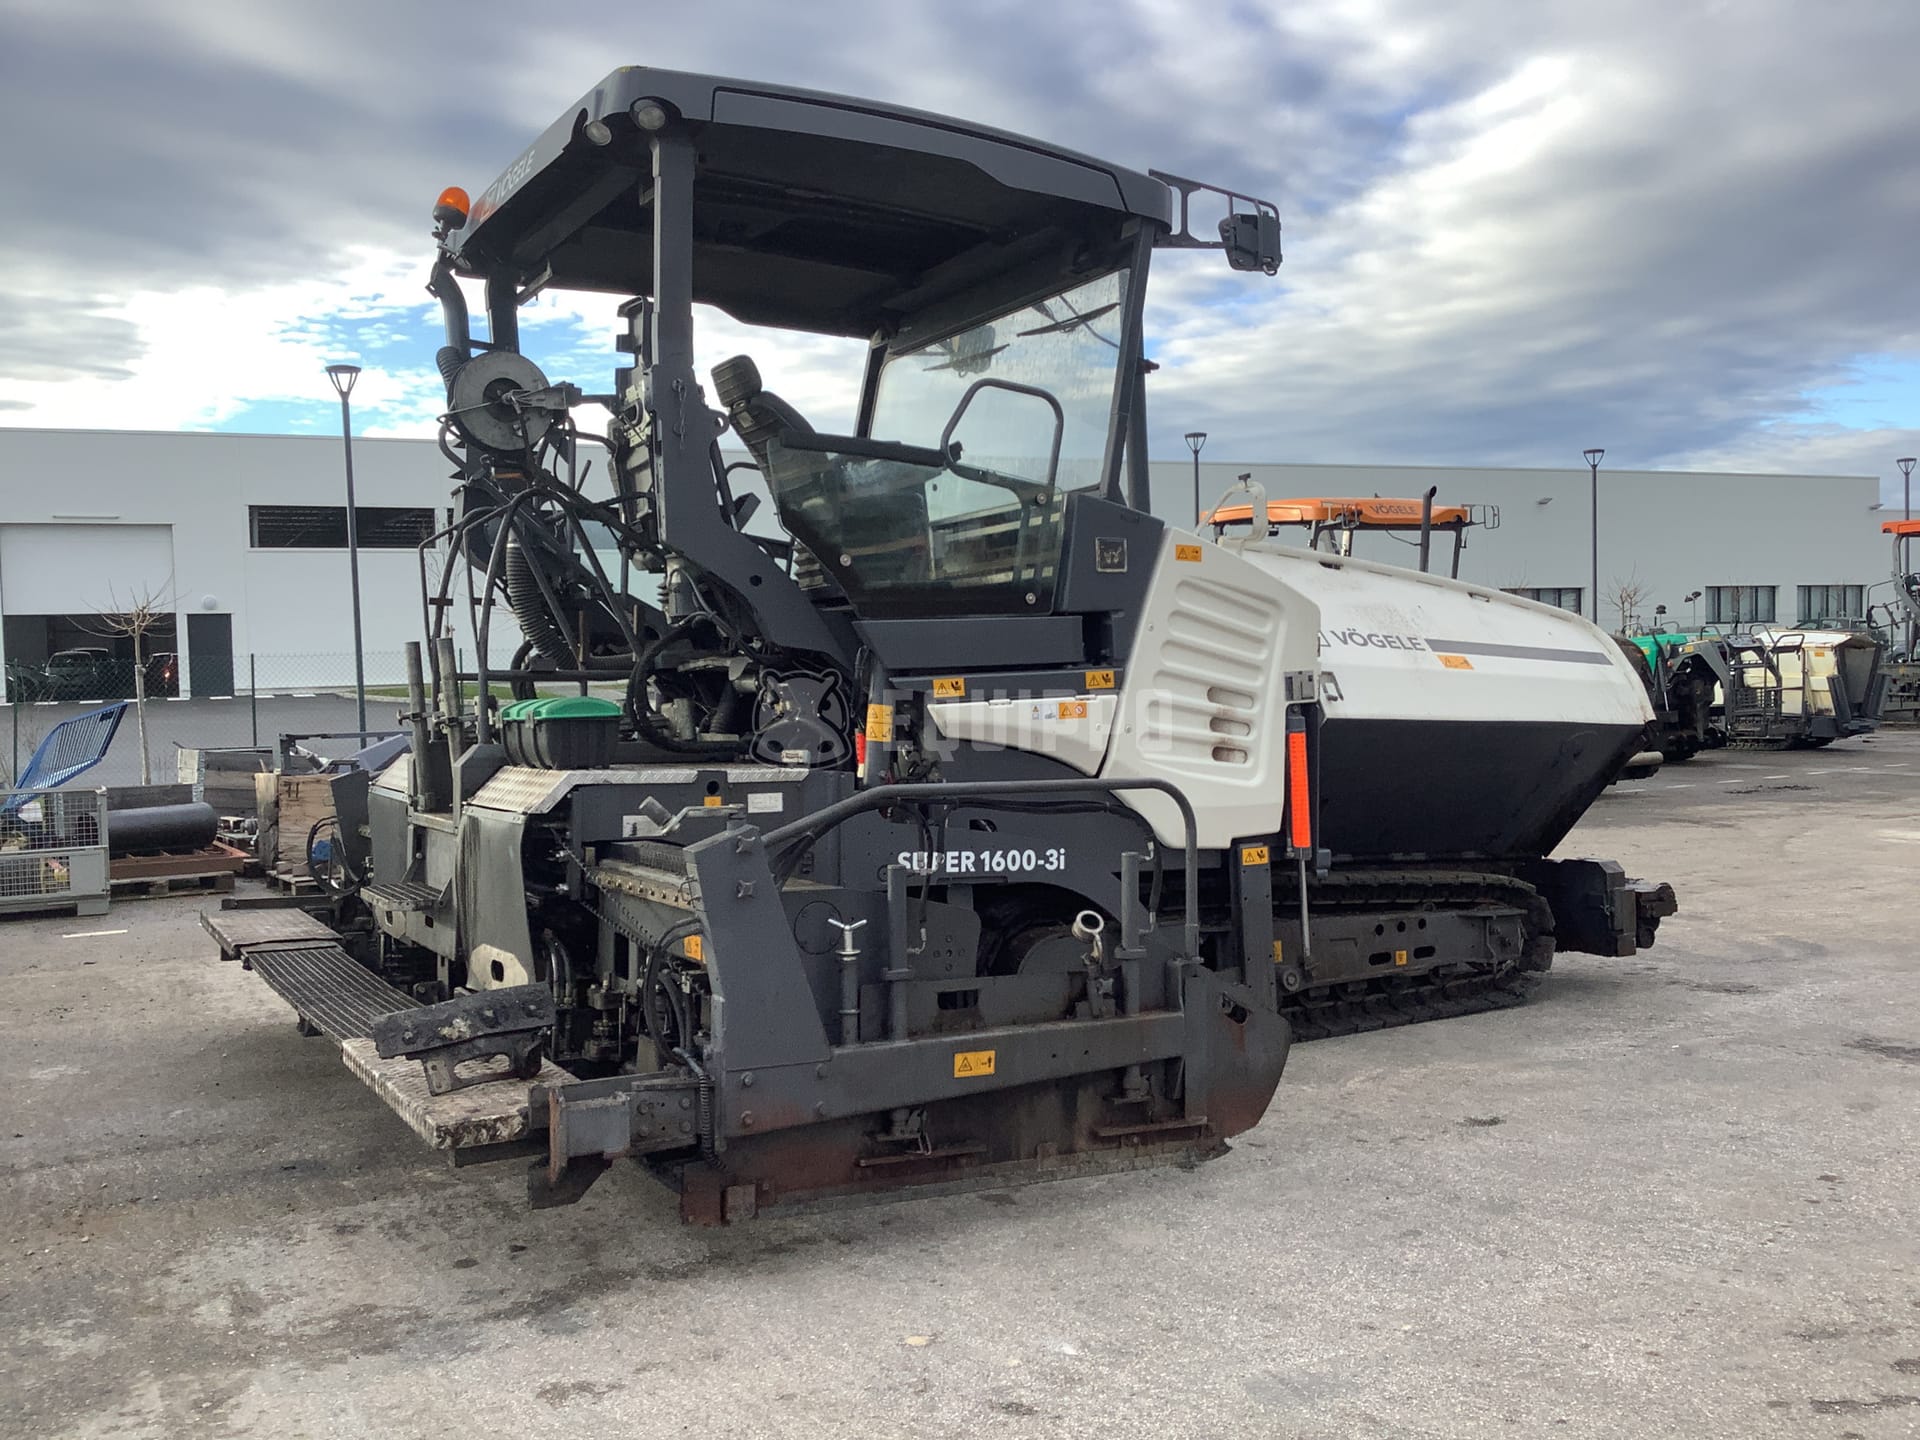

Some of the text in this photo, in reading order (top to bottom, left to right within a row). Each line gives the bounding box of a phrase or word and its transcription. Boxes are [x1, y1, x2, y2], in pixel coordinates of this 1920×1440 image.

[1369, 504, 1417, 515] VÖGELE
[1330, 628, 1426, 651] VÖGELE
[979, 847, 1066, 872] 1600-3i
